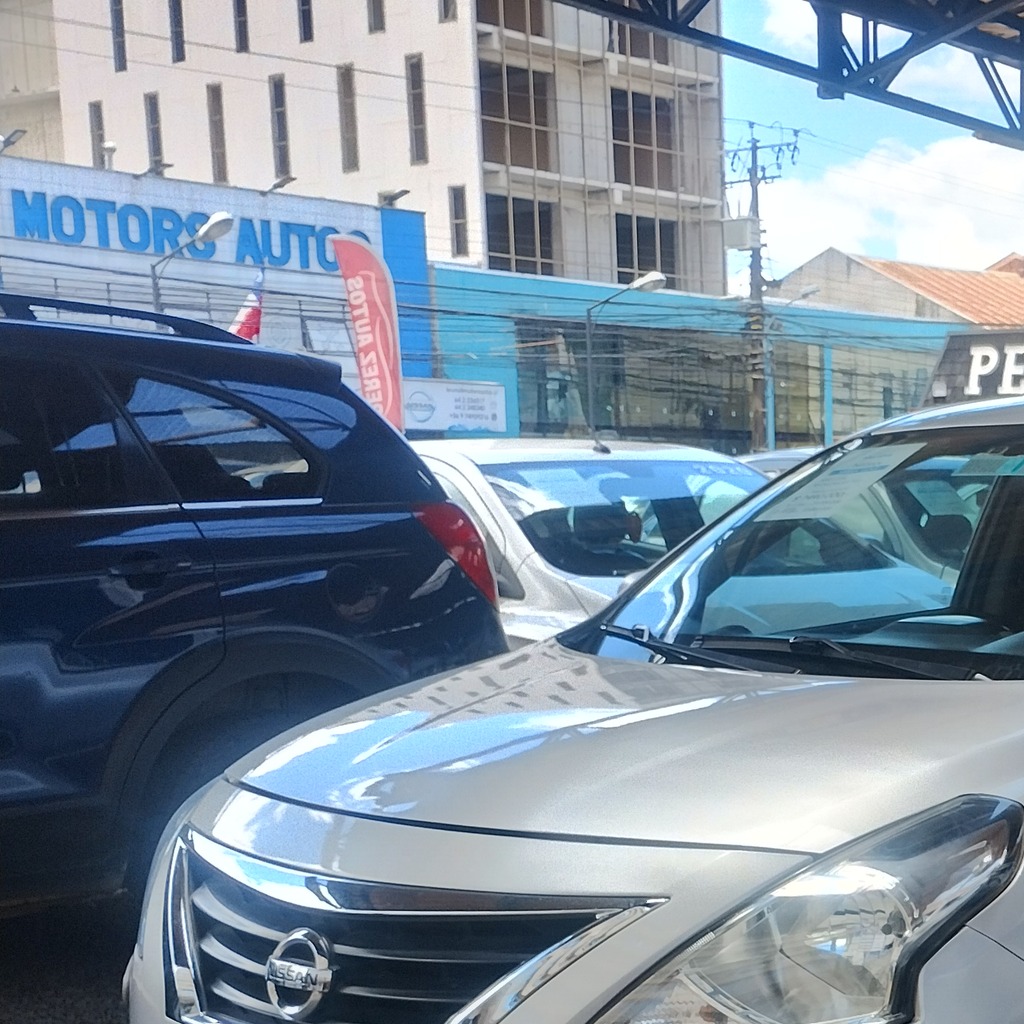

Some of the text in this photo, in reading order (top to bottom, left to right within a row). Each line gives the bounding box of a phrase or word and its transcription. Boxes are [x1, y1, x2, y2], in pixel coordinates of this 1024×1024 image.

[11, 189, 371, 273] MOTORS AUTO
[268, 960, 319, 987] NISSAN
